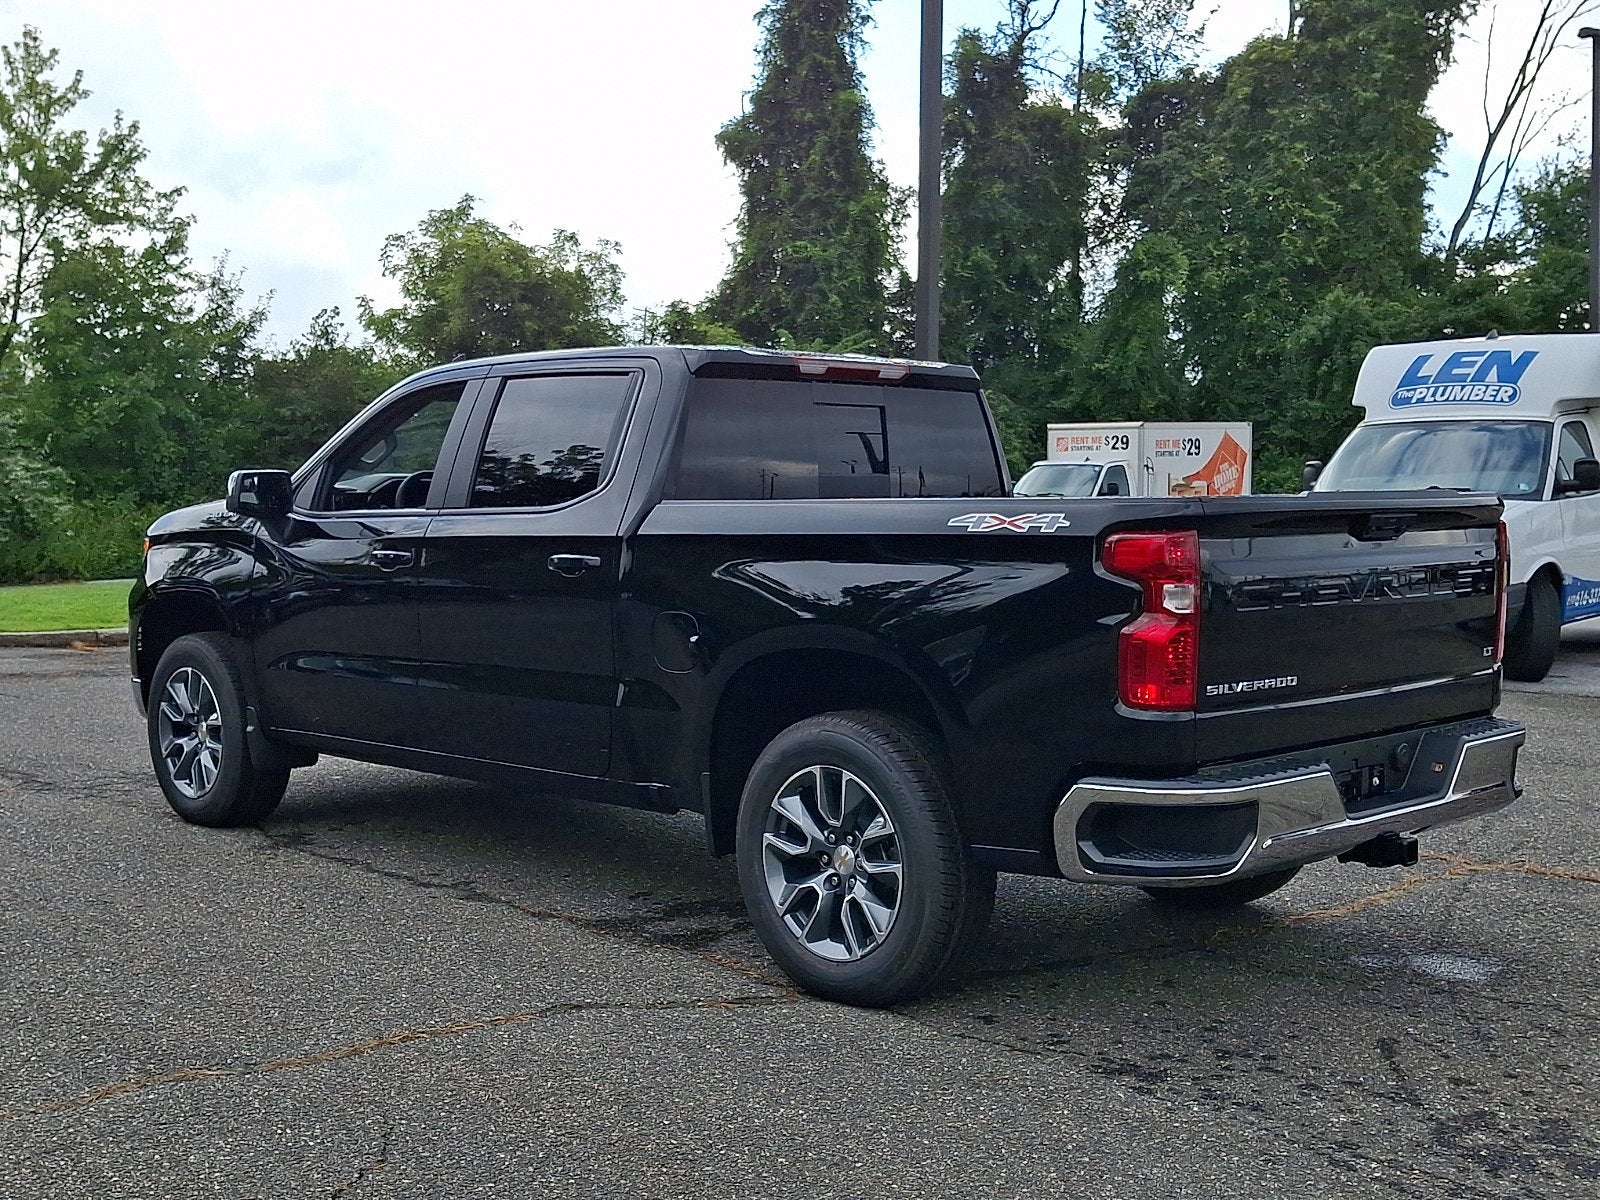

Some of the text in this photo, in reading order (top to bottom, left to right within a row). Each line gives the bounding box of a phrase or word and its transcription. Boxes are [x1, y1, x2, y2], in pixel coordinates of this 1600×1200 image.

[1397, 350, 1540, 391] LEN
[1411, 385, 1513, 403] PLUMBER
[1070, 436, 1088, 445] RENT
[1091, 436, 1103, 445] ME
[1104, 434, 1130, 451] $29
[1155, 439, 1180, 449] RENT ME
[1181, 437, 1201, 456] $29
[1206, 676, 1298, 696] SILVERADO
